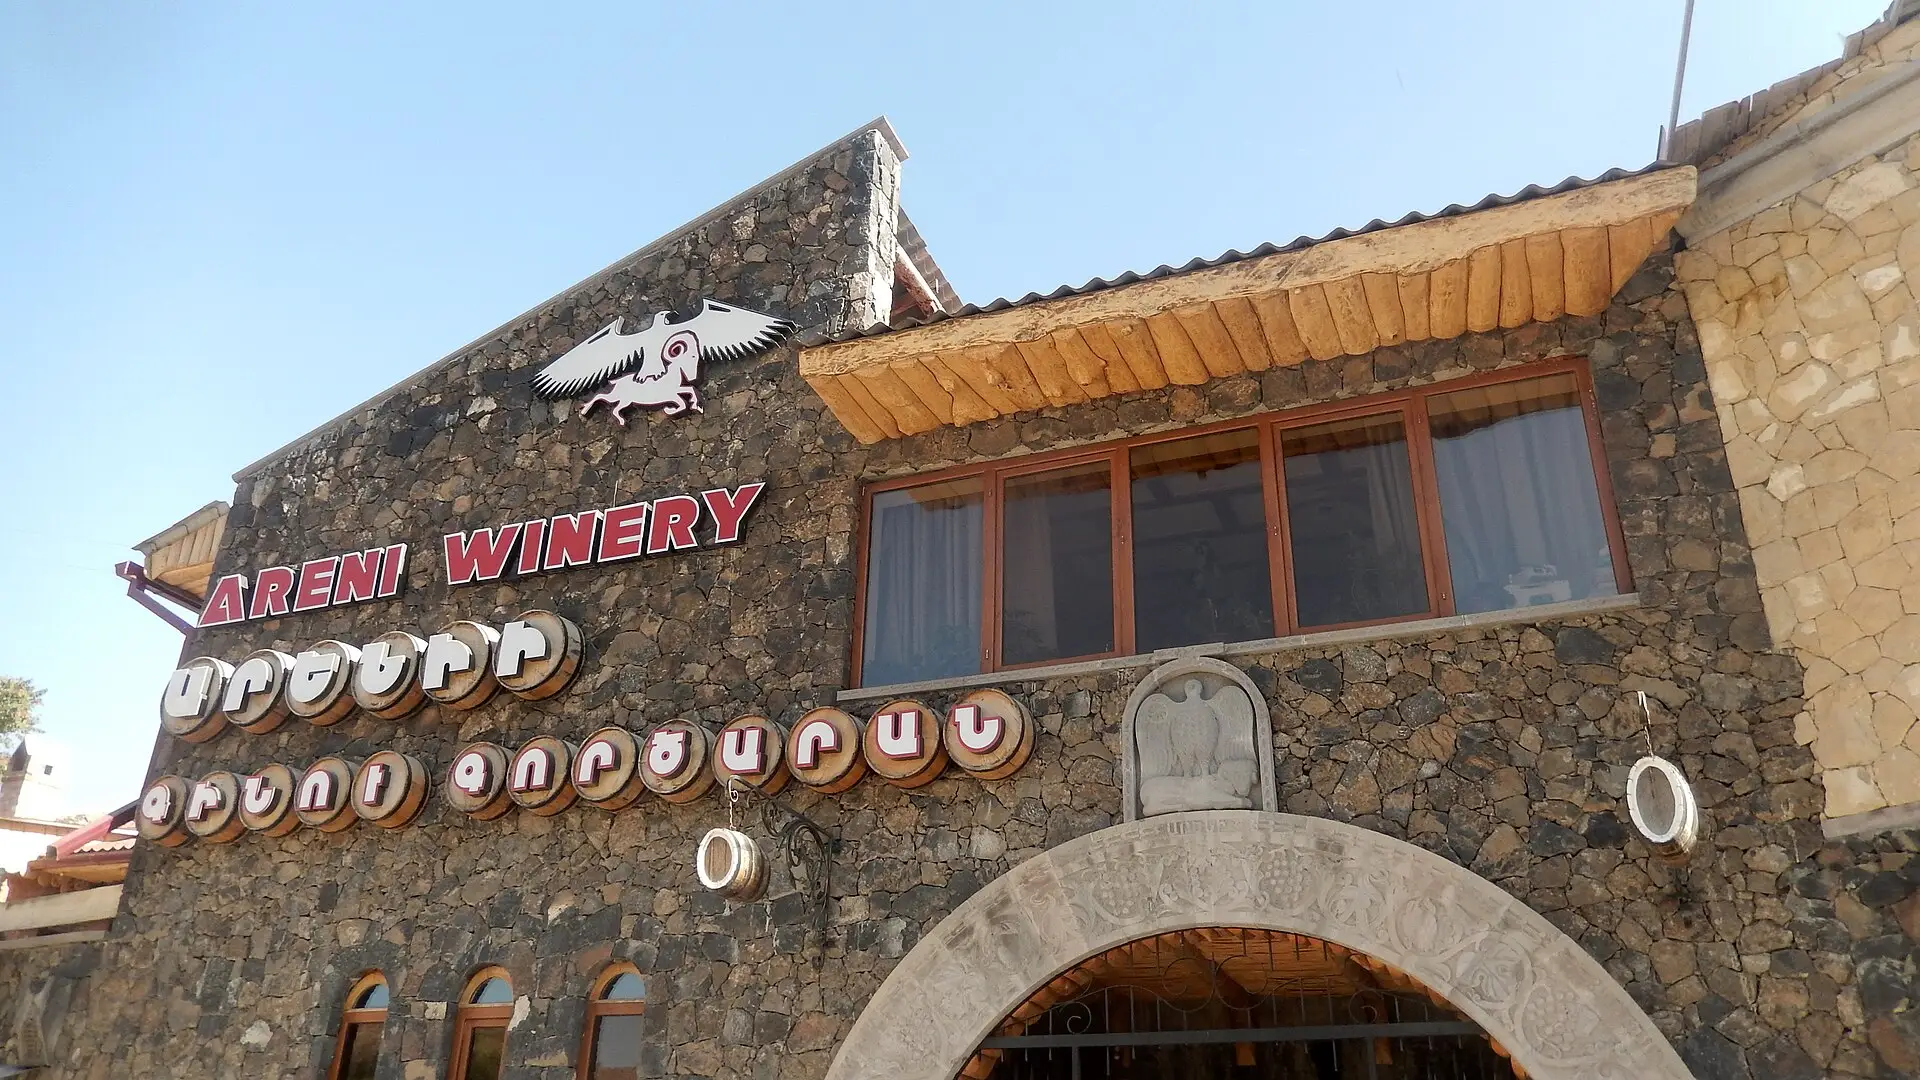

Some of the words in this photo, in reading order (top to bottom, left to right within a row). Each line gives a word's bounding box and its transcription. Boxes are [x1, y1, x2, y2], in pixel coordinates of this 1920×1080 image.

[199, 544, 407, 627] ARENI
[443, 482, 765, 585] WINERY
[163, 620, 548, 717] ԱՐԵՆԻԻ
[452, 704, 1004, 794] ԳՈՐԾԱՐԱՆ
